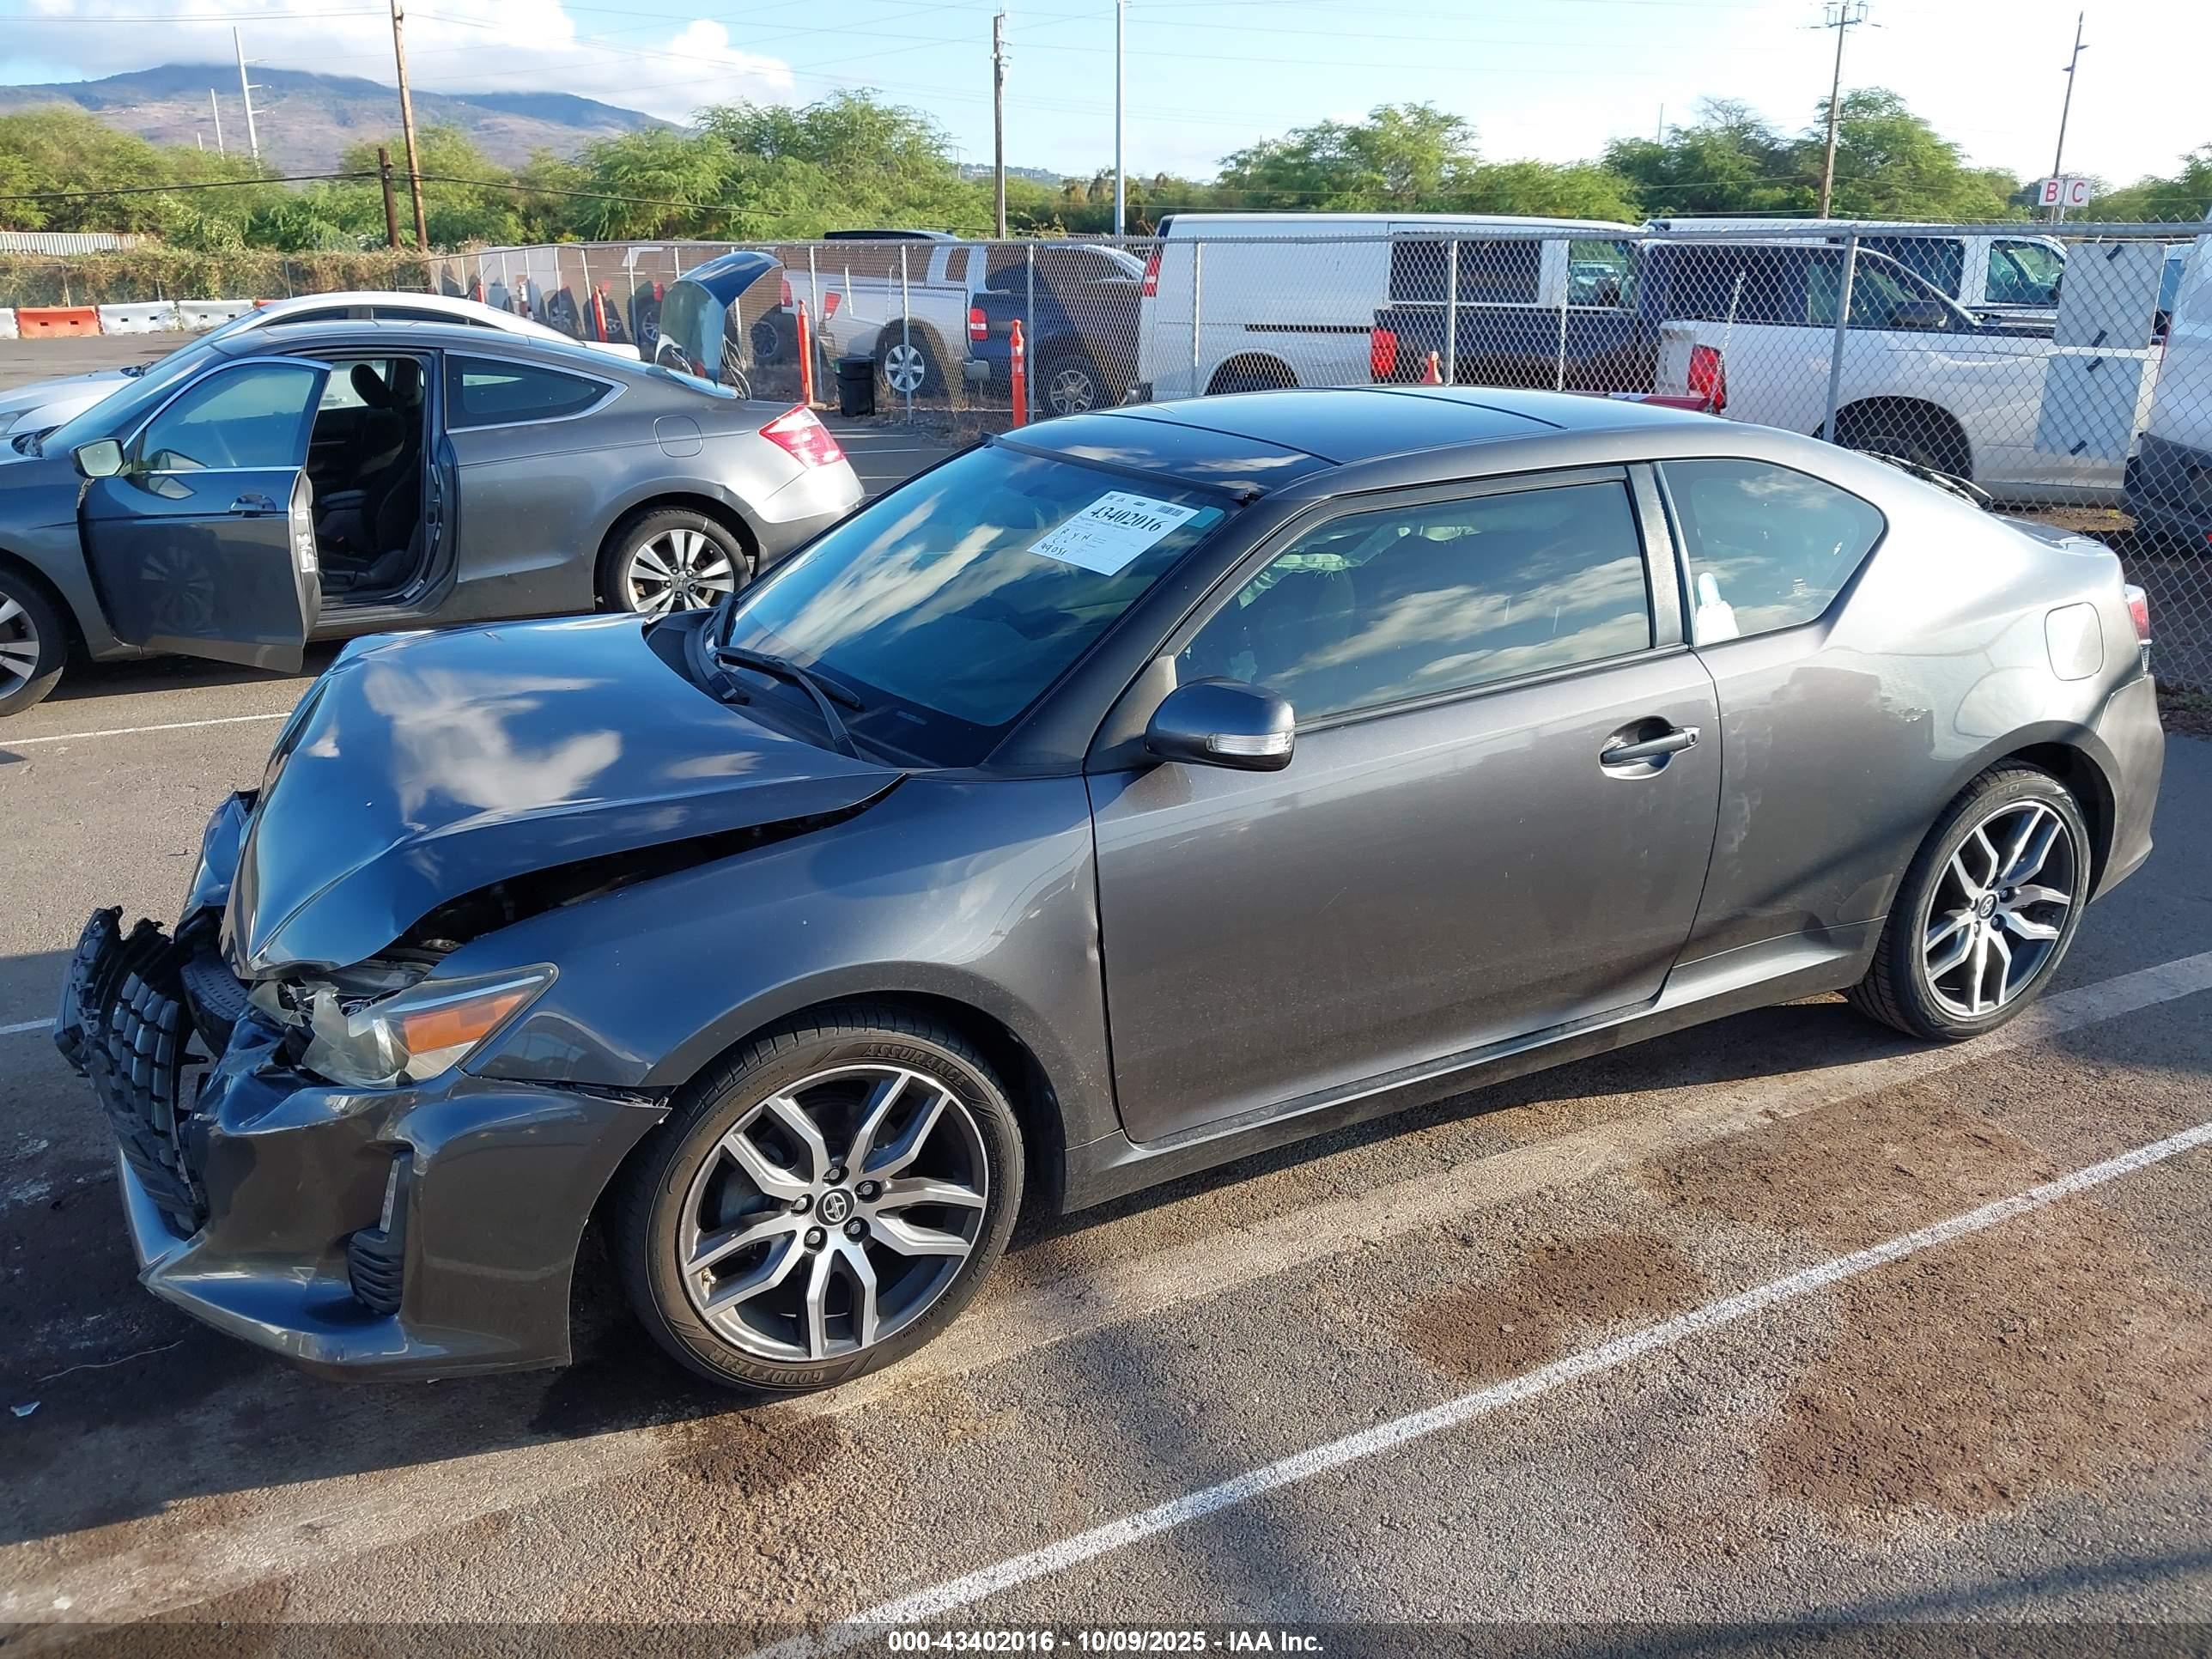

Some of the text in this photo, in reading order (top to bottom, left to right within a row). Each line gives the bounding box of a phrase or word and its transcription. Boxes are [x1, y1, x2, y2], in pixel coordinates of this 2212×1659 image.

[2045, 182, 2058, 202] B
[2072, 182, 2085, 203] C
[1091, 506, 1169, 532] 43402016
[863, 1044, 969, 1085] ASSURANCE
